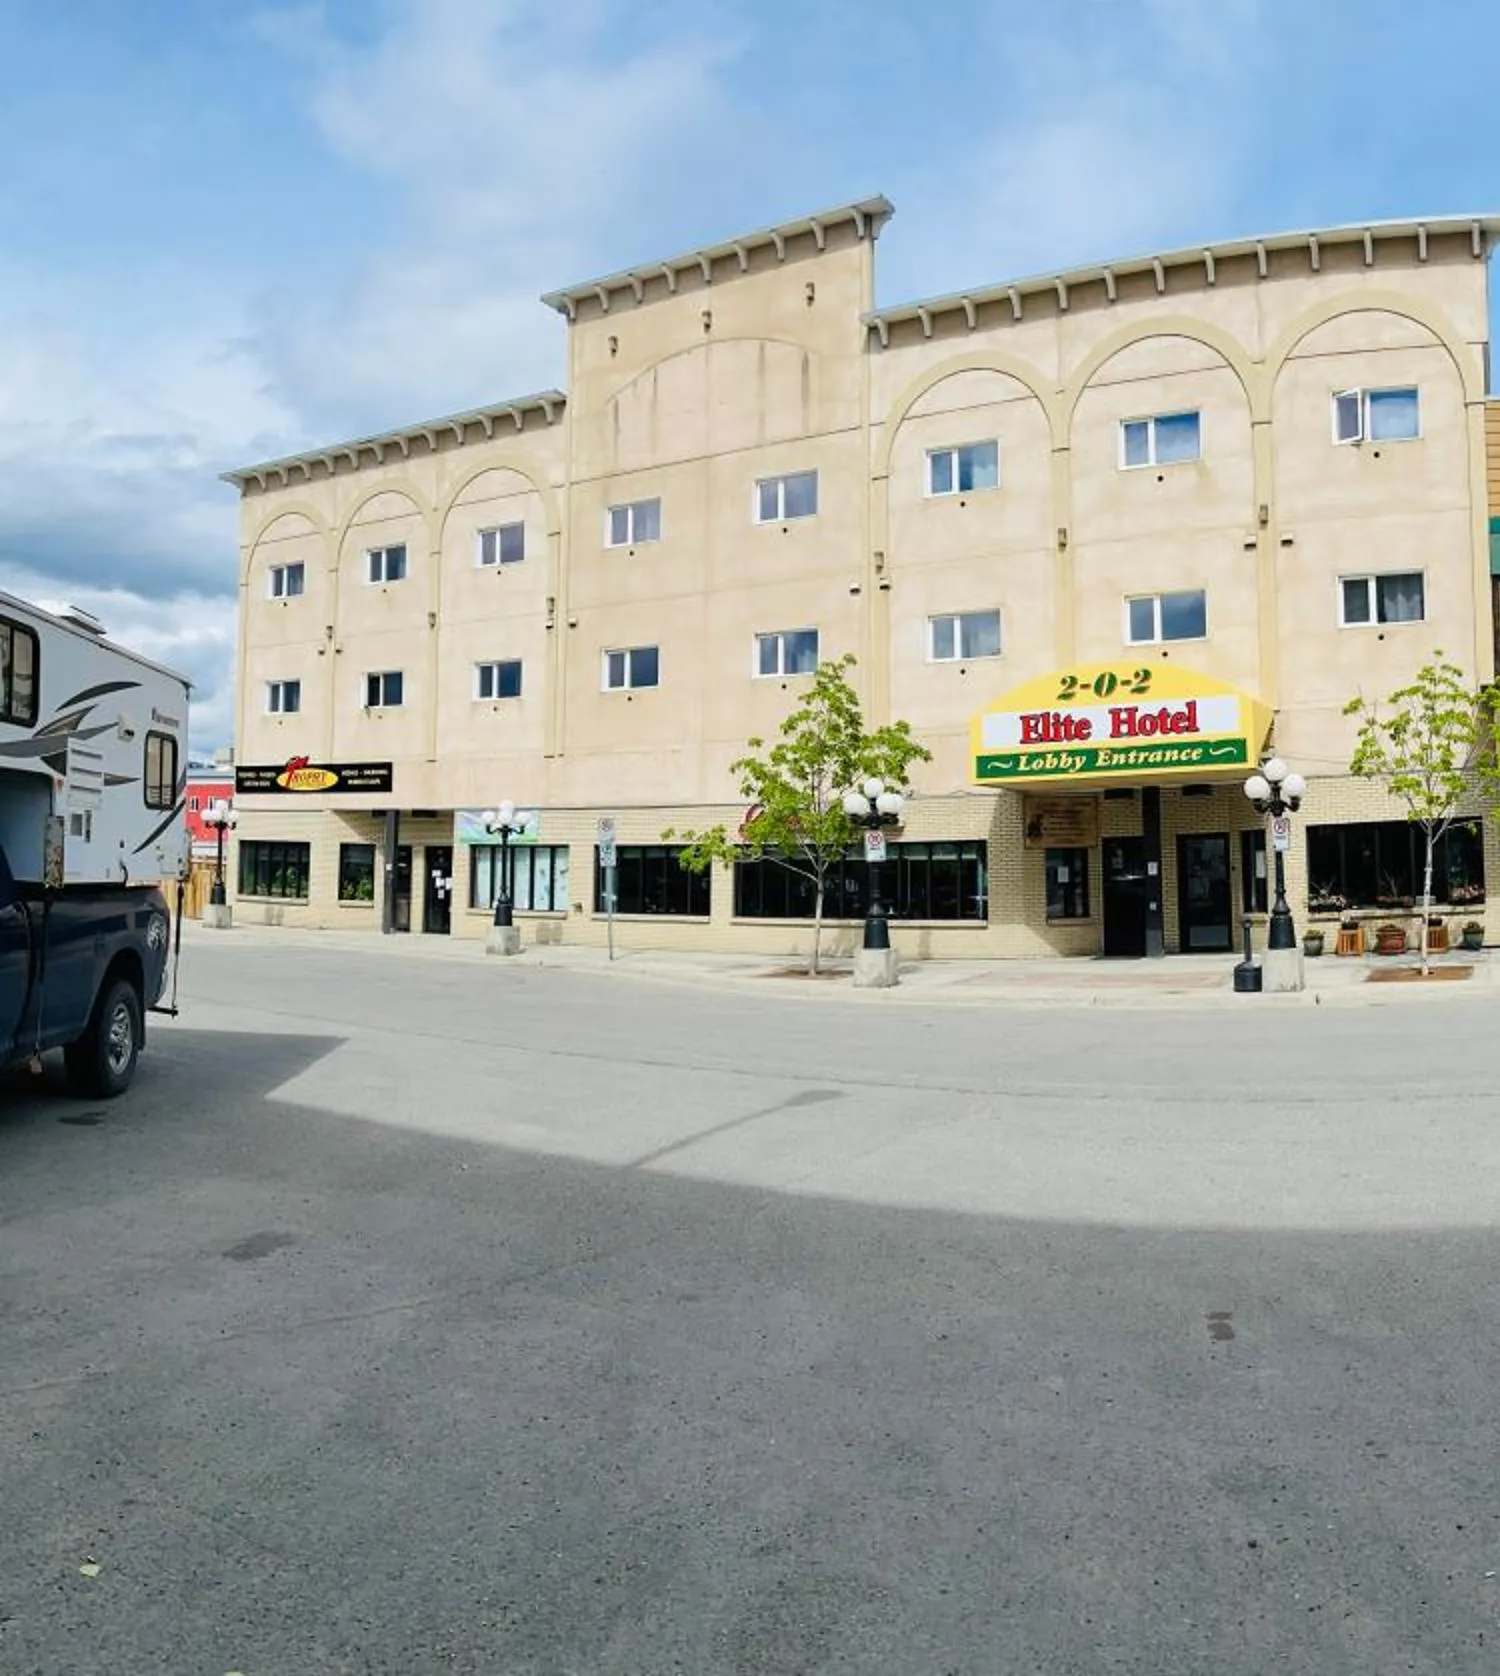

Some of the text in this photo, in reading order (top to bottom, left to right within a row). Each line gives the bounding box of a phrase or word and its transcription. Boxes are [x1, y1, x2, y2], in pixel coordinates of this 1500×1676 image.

[1057, 668, 1152, 700] 2-0-2
[1019, 700, 1200, 745] Elite Hotel
[1017, 746, 1203, 772] Lobby Entrance
